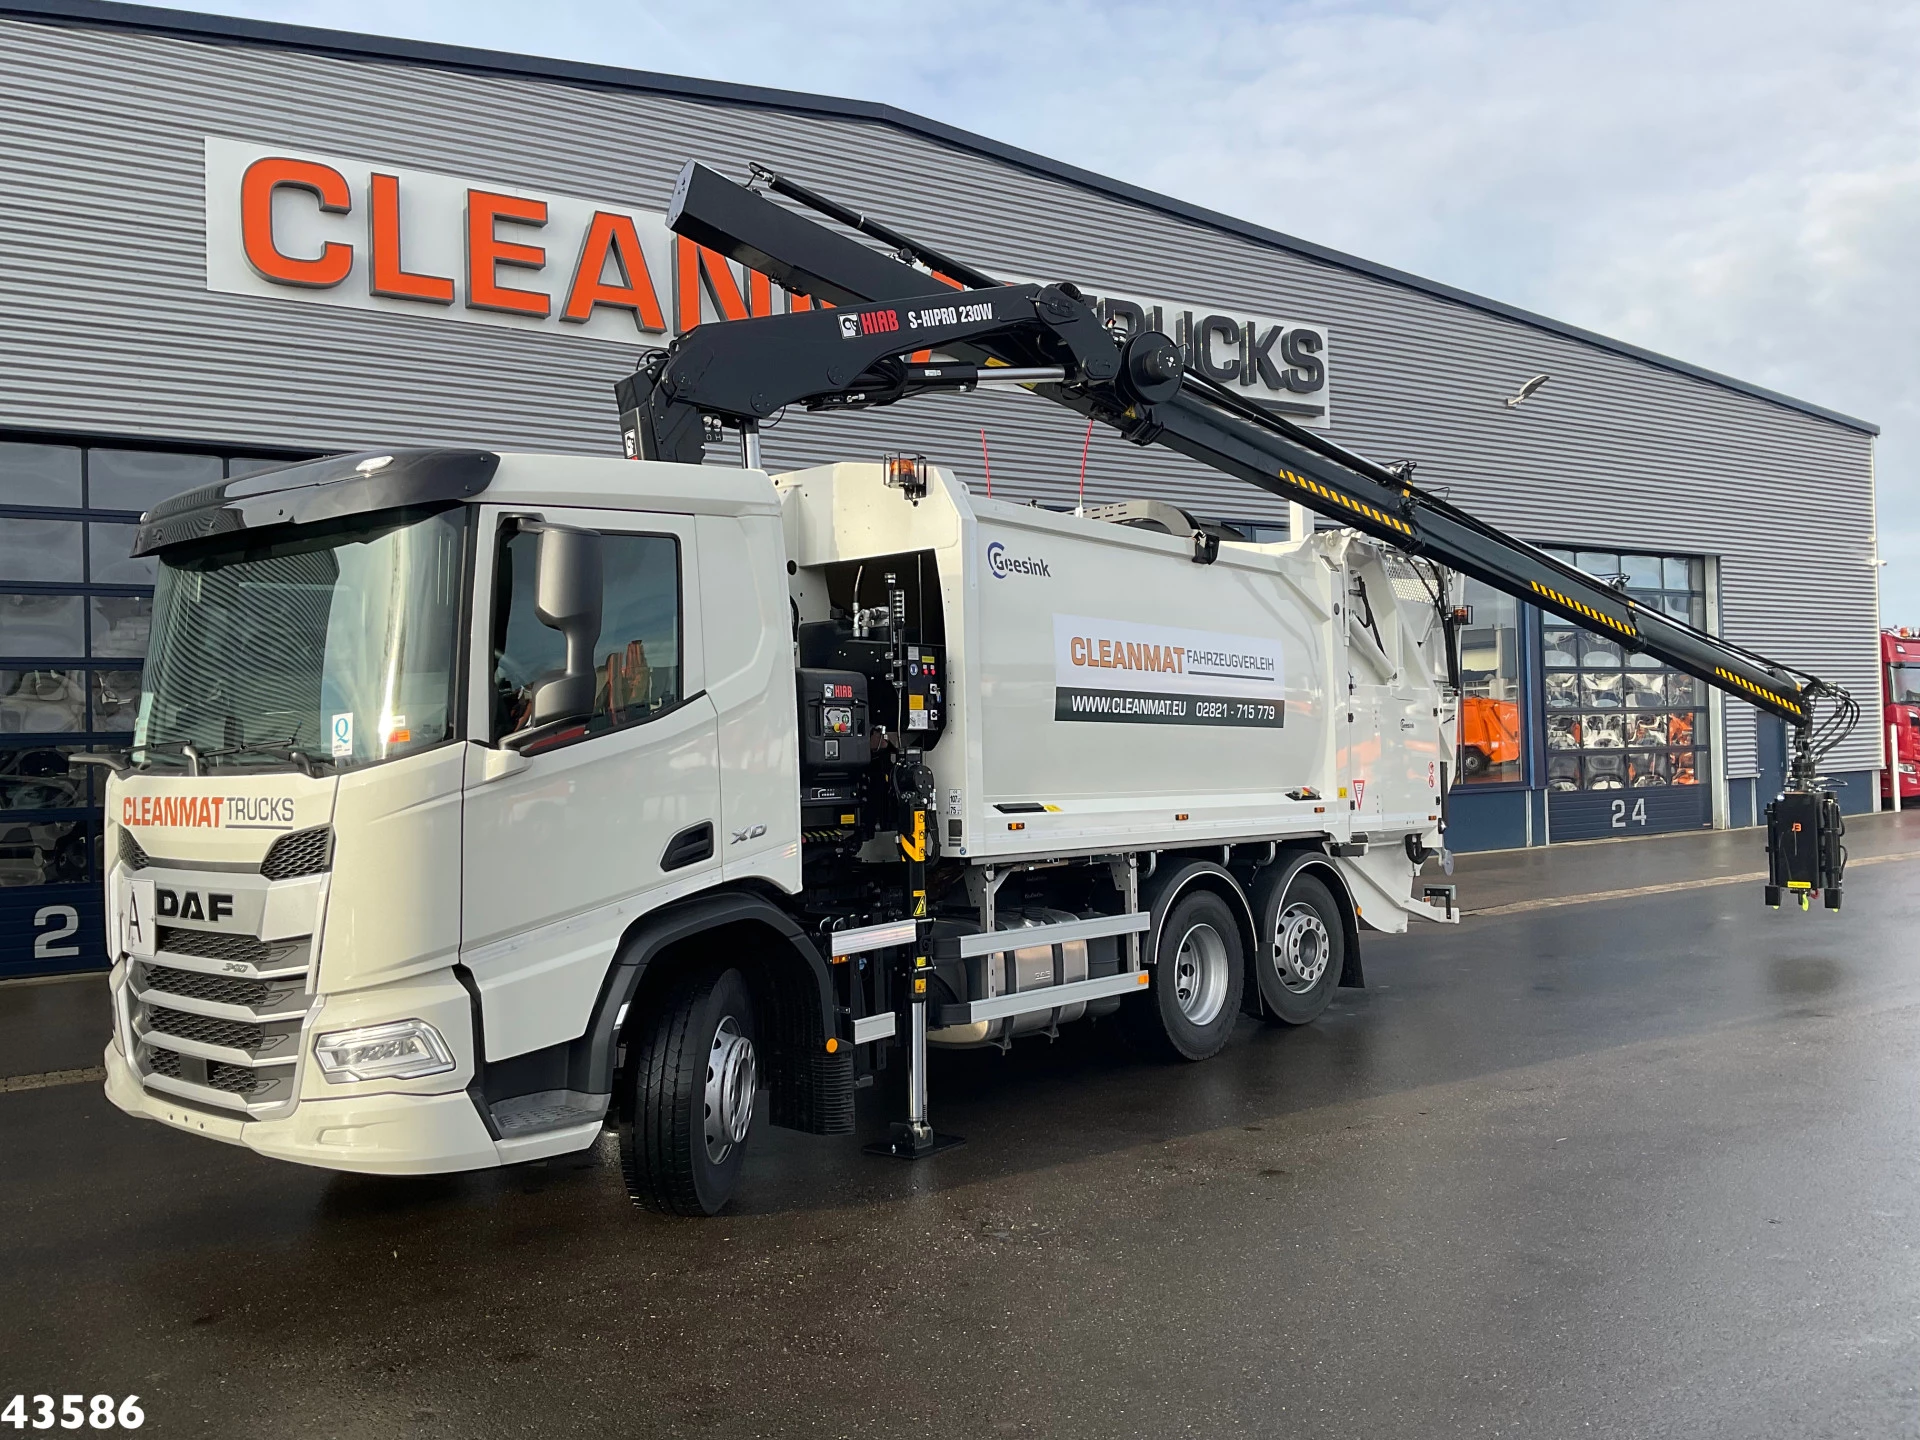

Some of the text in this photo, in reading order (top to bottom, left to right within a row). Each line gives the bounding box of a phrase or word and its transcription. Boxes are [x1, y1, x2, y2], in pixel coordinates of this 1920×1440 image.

[860, 309, 899, 335] HIAB
[907, 303, 993, 329] S-HIPRO 230W
[993, 550, 1051, 578] Geesink
[1071, 637, 1275, 674] CLEANMAT FAHRZEUGVERLEIH
[834, 685, 853, 698] HIAB
[1072, 695, 1187, 717] WWW.CLEANMAT.EU
[1196, 701, 1228, 718] 02821
[1237, 704, 1255, 719] 715
[1257, 704, 1275, 720] 779
[335, 717, 350, 744] Q
[123, 796, 295, 828] CLEANMAT TRUCKS
[1612, 798, 1647, 828] 24
[128, 887, 142, 943] A
[157, 888, 233, 922] DAF
[34, 905, 79, 959] 2
